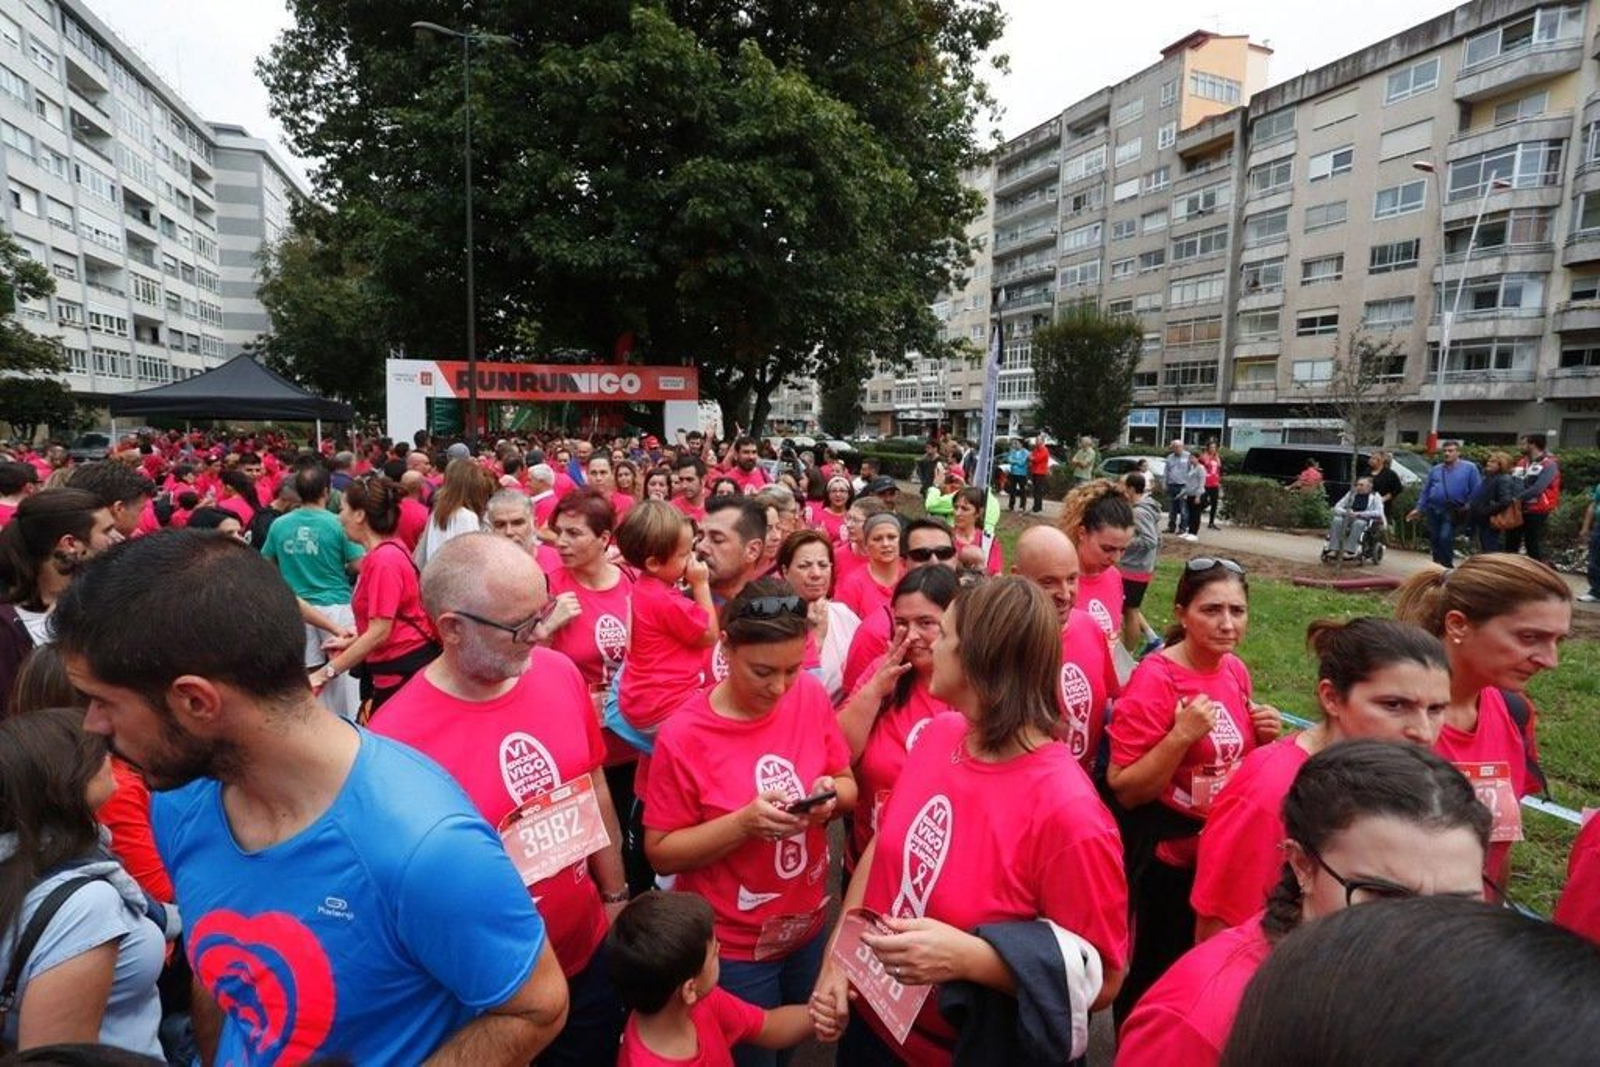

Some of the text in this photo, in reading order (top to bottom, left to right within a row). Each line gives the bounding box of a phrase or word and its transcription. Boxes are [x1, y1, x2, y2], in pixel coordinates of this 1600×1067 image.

[508, 741, 528, 758] VI
[509, 758, 546, 781] VIGO
[519, 806, 585, 858] 3982
